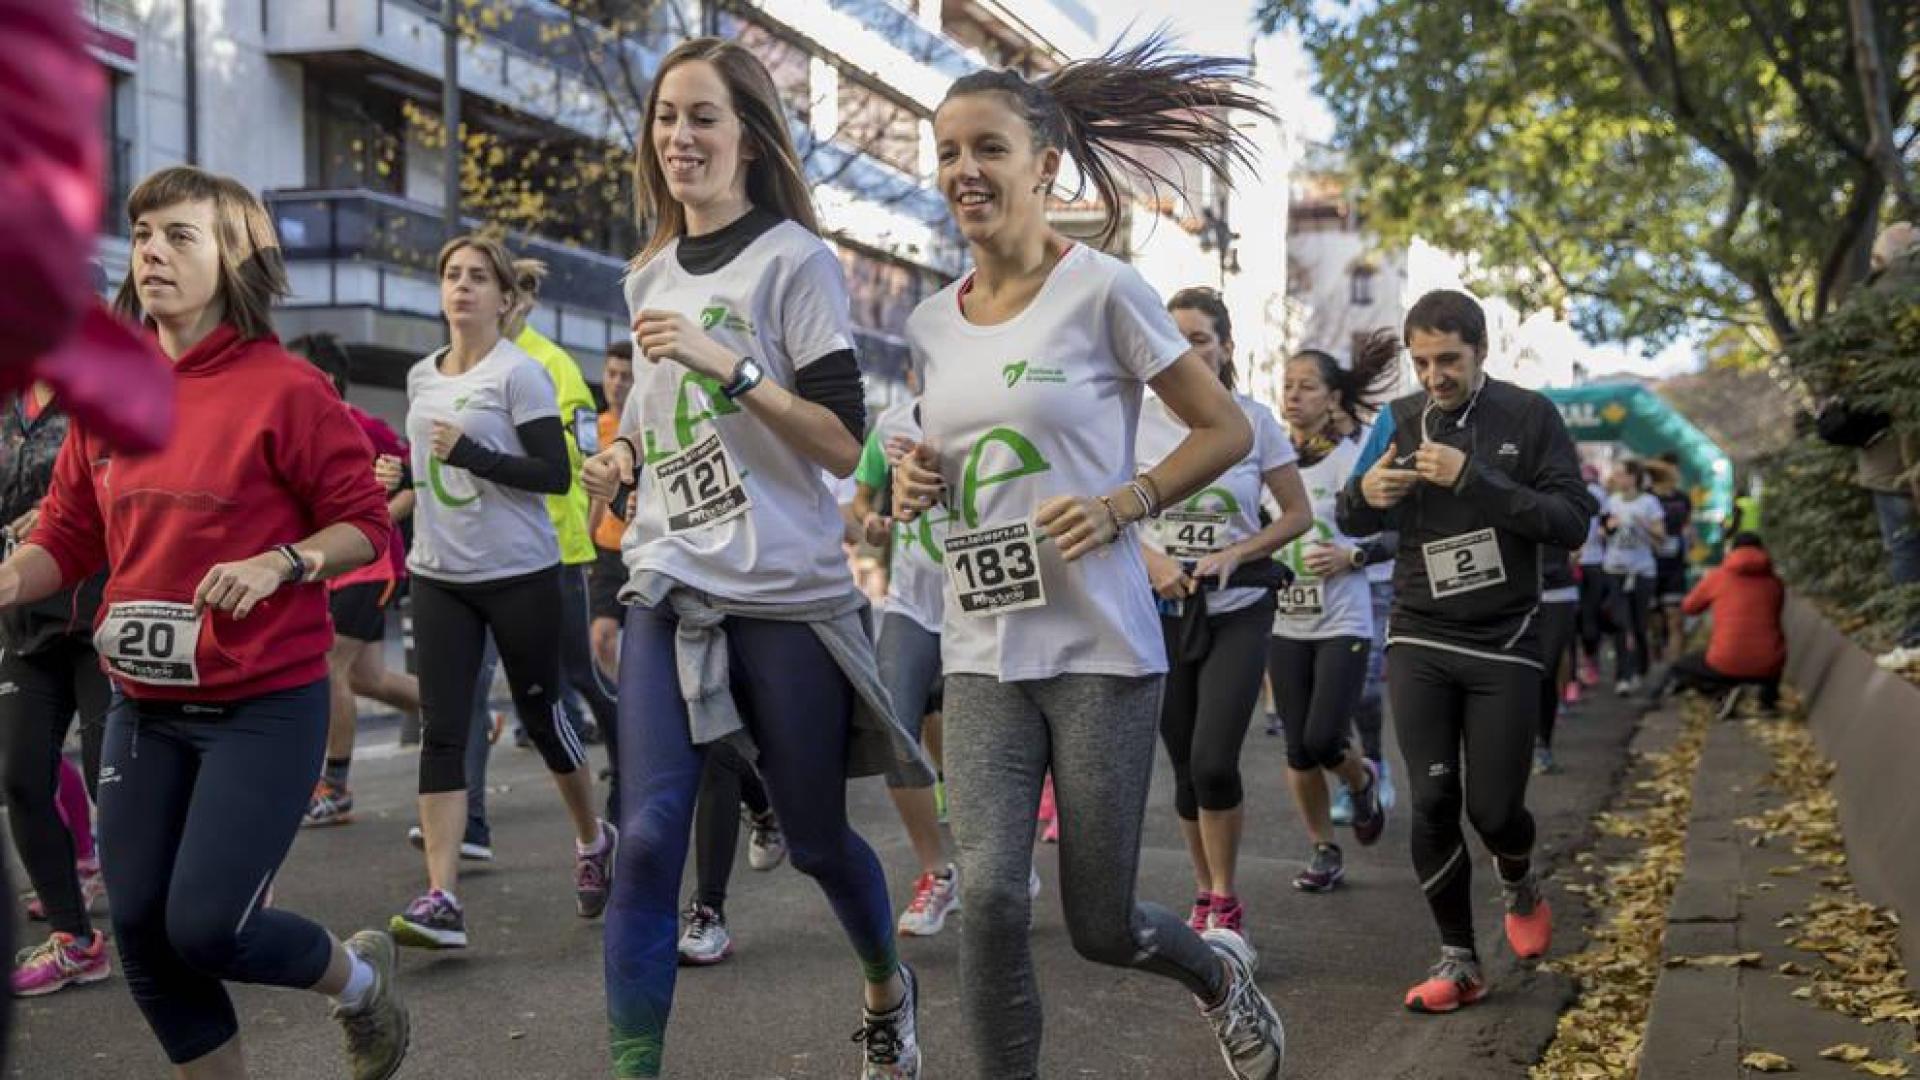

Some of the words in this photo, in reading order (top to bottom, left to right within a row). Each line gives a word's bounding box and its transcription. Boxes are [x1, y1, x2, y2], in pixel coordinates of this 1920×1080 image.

[1178, 524, 1215, 546] 44
[955, 542, 1035, 589] 183
[1455, 549, 1476, 573] 2
[119, 620, 175, 658] 20
